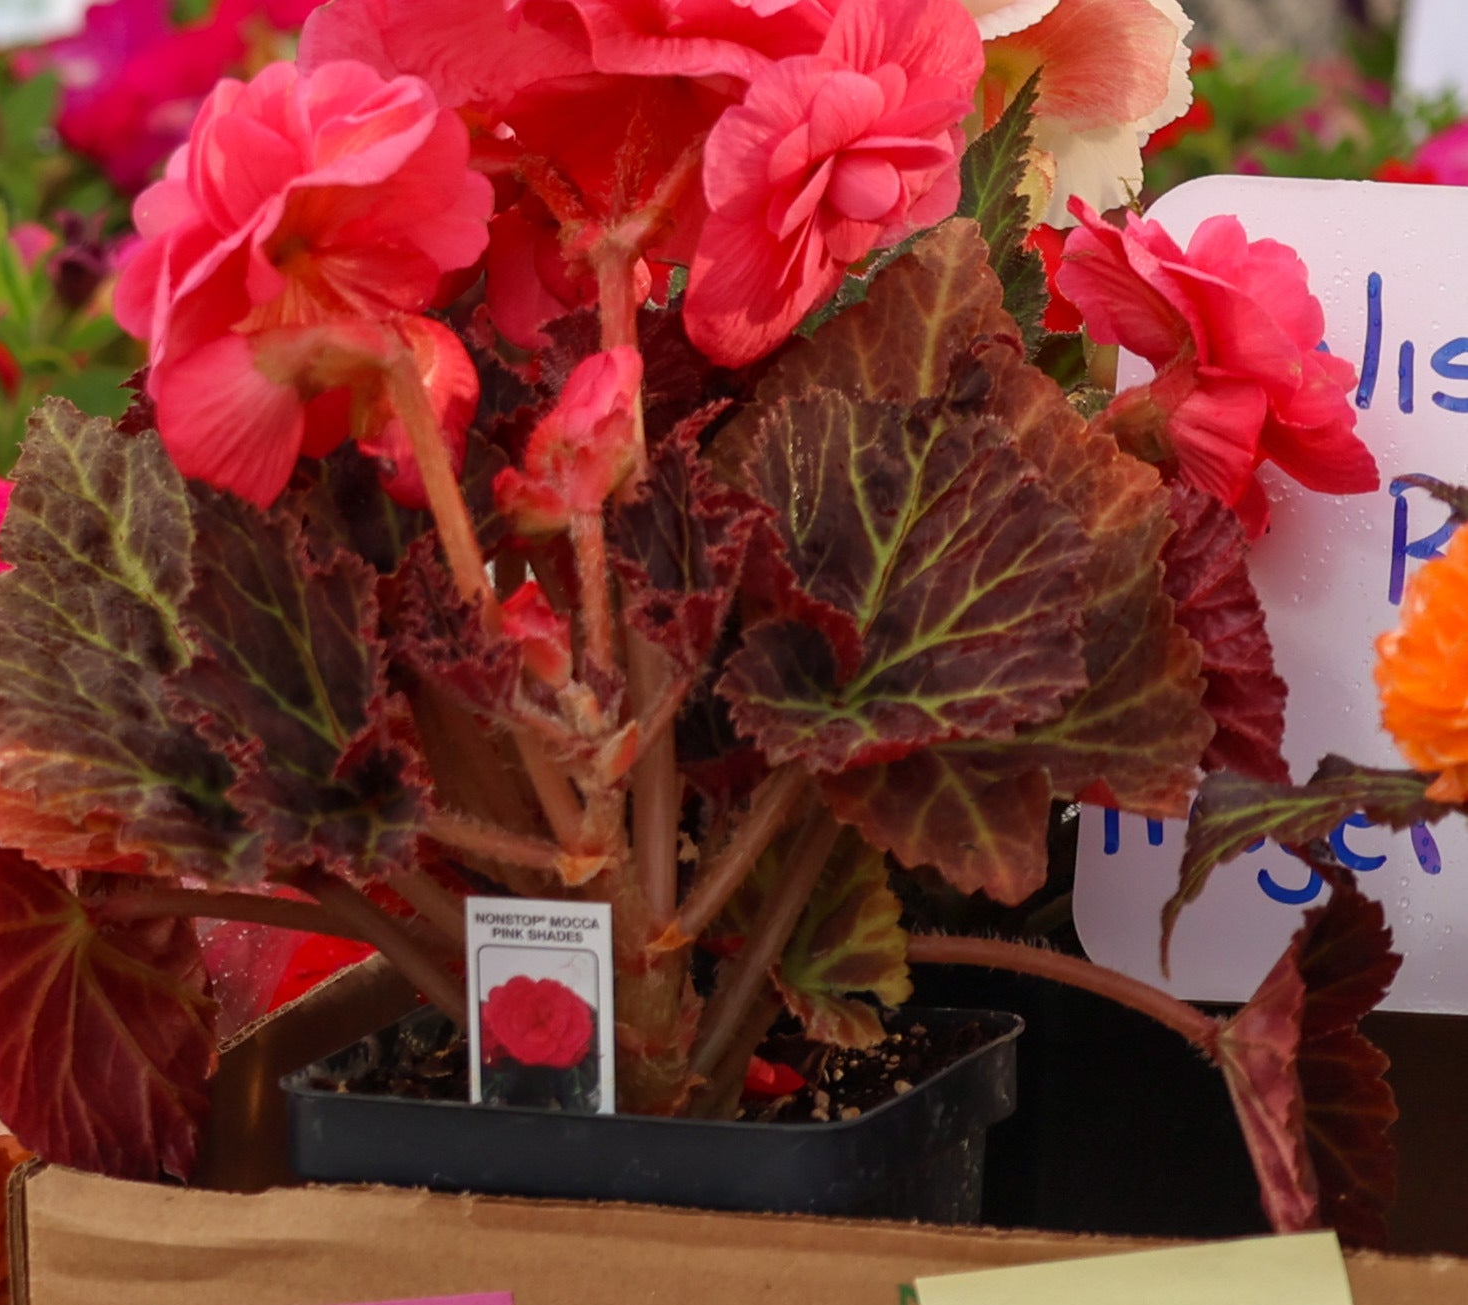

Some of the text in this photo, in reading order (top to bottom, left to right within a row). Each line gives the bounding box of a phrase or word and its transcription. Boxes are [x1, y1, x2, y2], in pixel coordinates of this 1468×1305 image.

[549, 915, 600, 930] MOCCA
[492, 927, 584, 943] PINK SHADES
